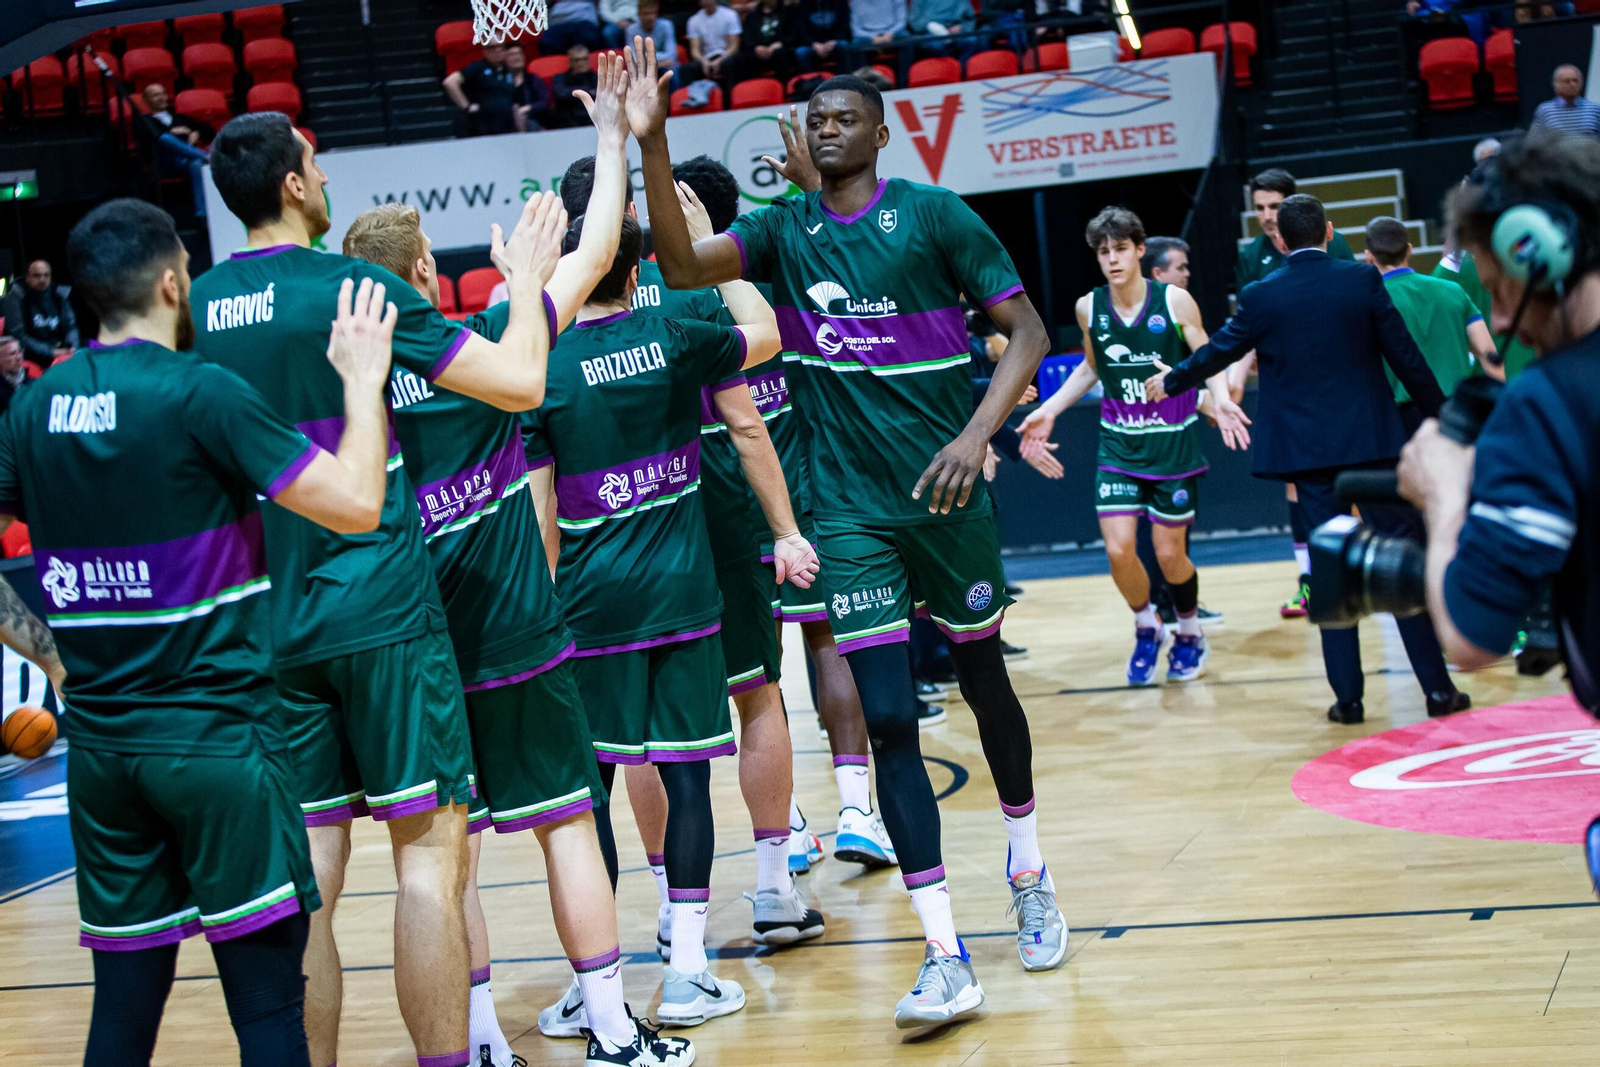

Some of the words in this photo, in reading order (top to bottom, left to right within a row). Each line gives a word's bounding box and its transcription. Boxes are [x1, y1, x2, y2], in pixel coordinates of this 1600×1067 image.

[986, 121, 1177, 165] VERSTRAETE
[206, 282, 275, 332] KRAVIĆ
[846, 296, 897, 315] Unicaja
[842, 336, 866, 344] COSTA
[866, 336, 881, 344] DEL
[580, 341, 667, 387] BRIZUELA
[1121, 378, 1148, 405] 34
[430, 506, 457, 523] Deporte
[852, 587, 892, 602] MÁLAGA
